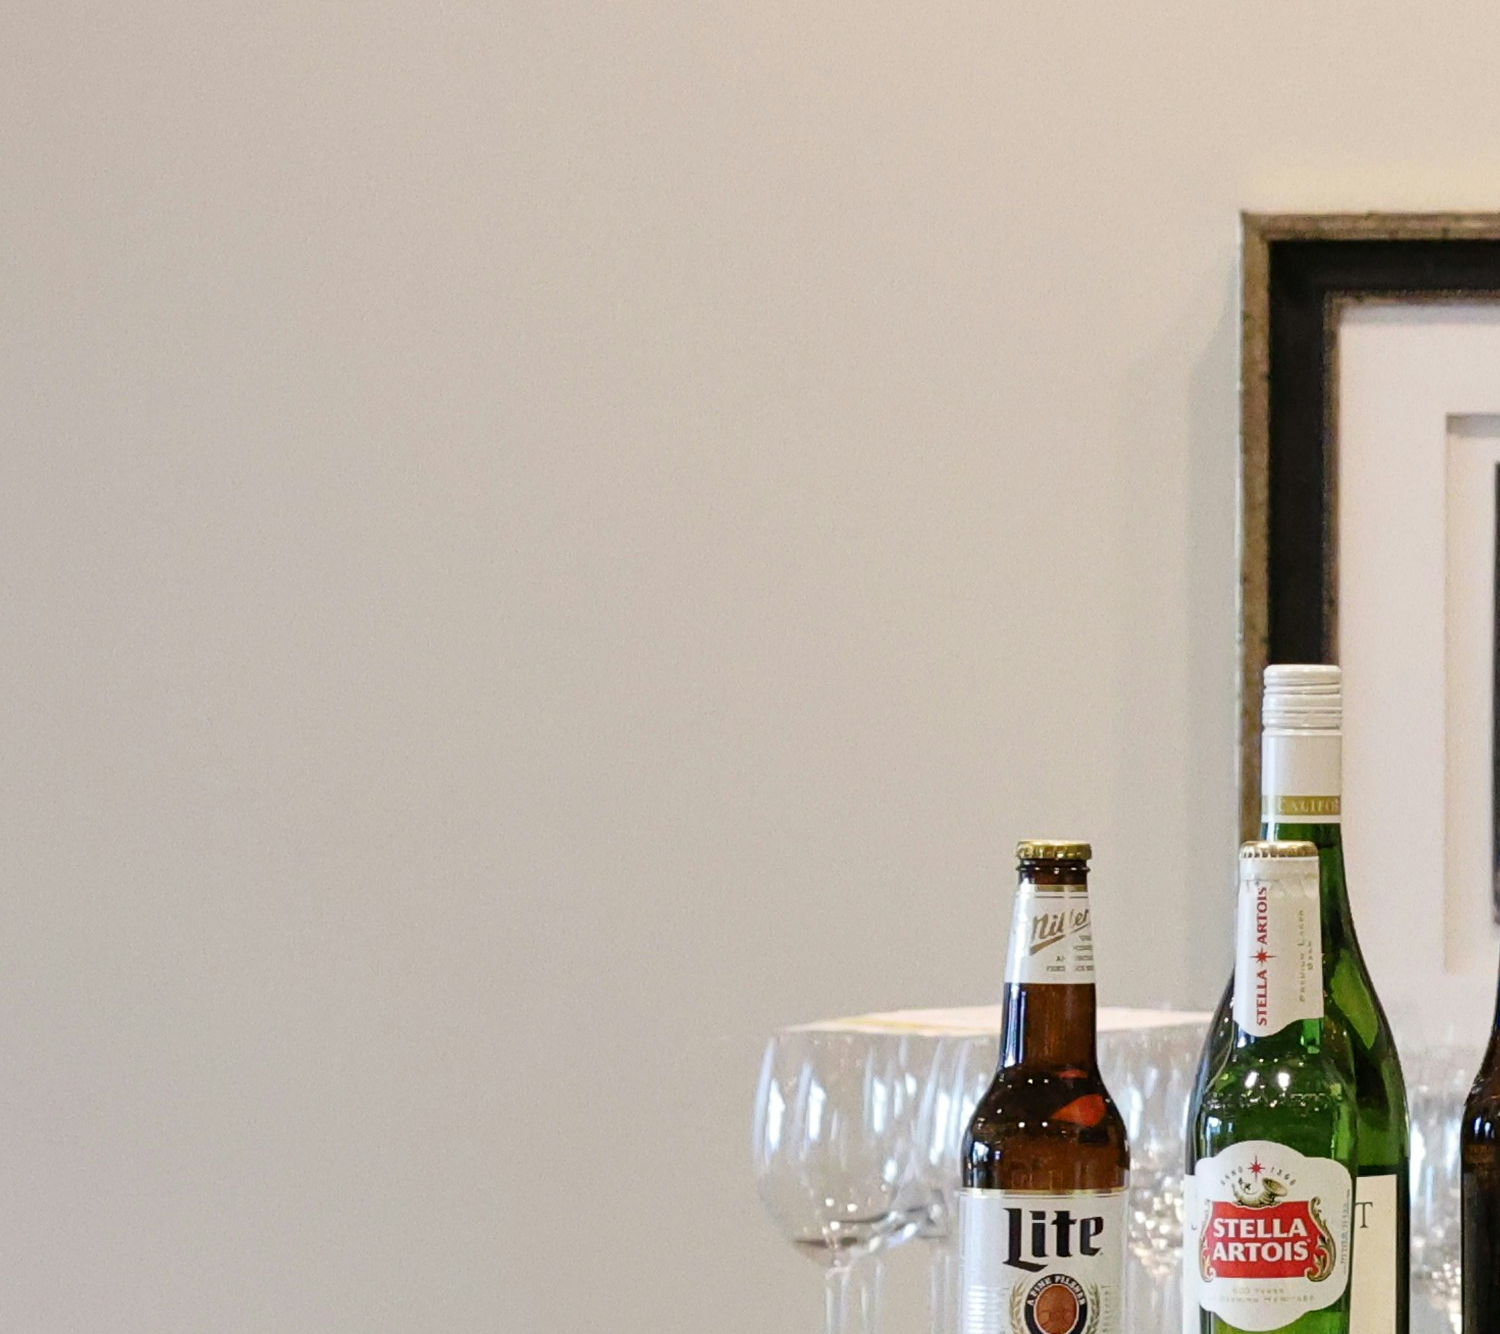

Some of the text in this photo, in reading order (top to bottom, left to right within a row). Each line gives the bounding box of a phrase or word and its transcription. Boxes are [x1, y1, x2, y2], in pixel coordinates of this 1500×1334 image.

[1256, 886, 1268, 1026] STELLA ARTOIS
[1213, 1218, 1308, 1238] STELLA
[1003, 1208, 1104, 1273] Lite
[1213, 1241, 1309, 1262] ARTOIS
[1031, 1277, 1053, 1297] FINE
